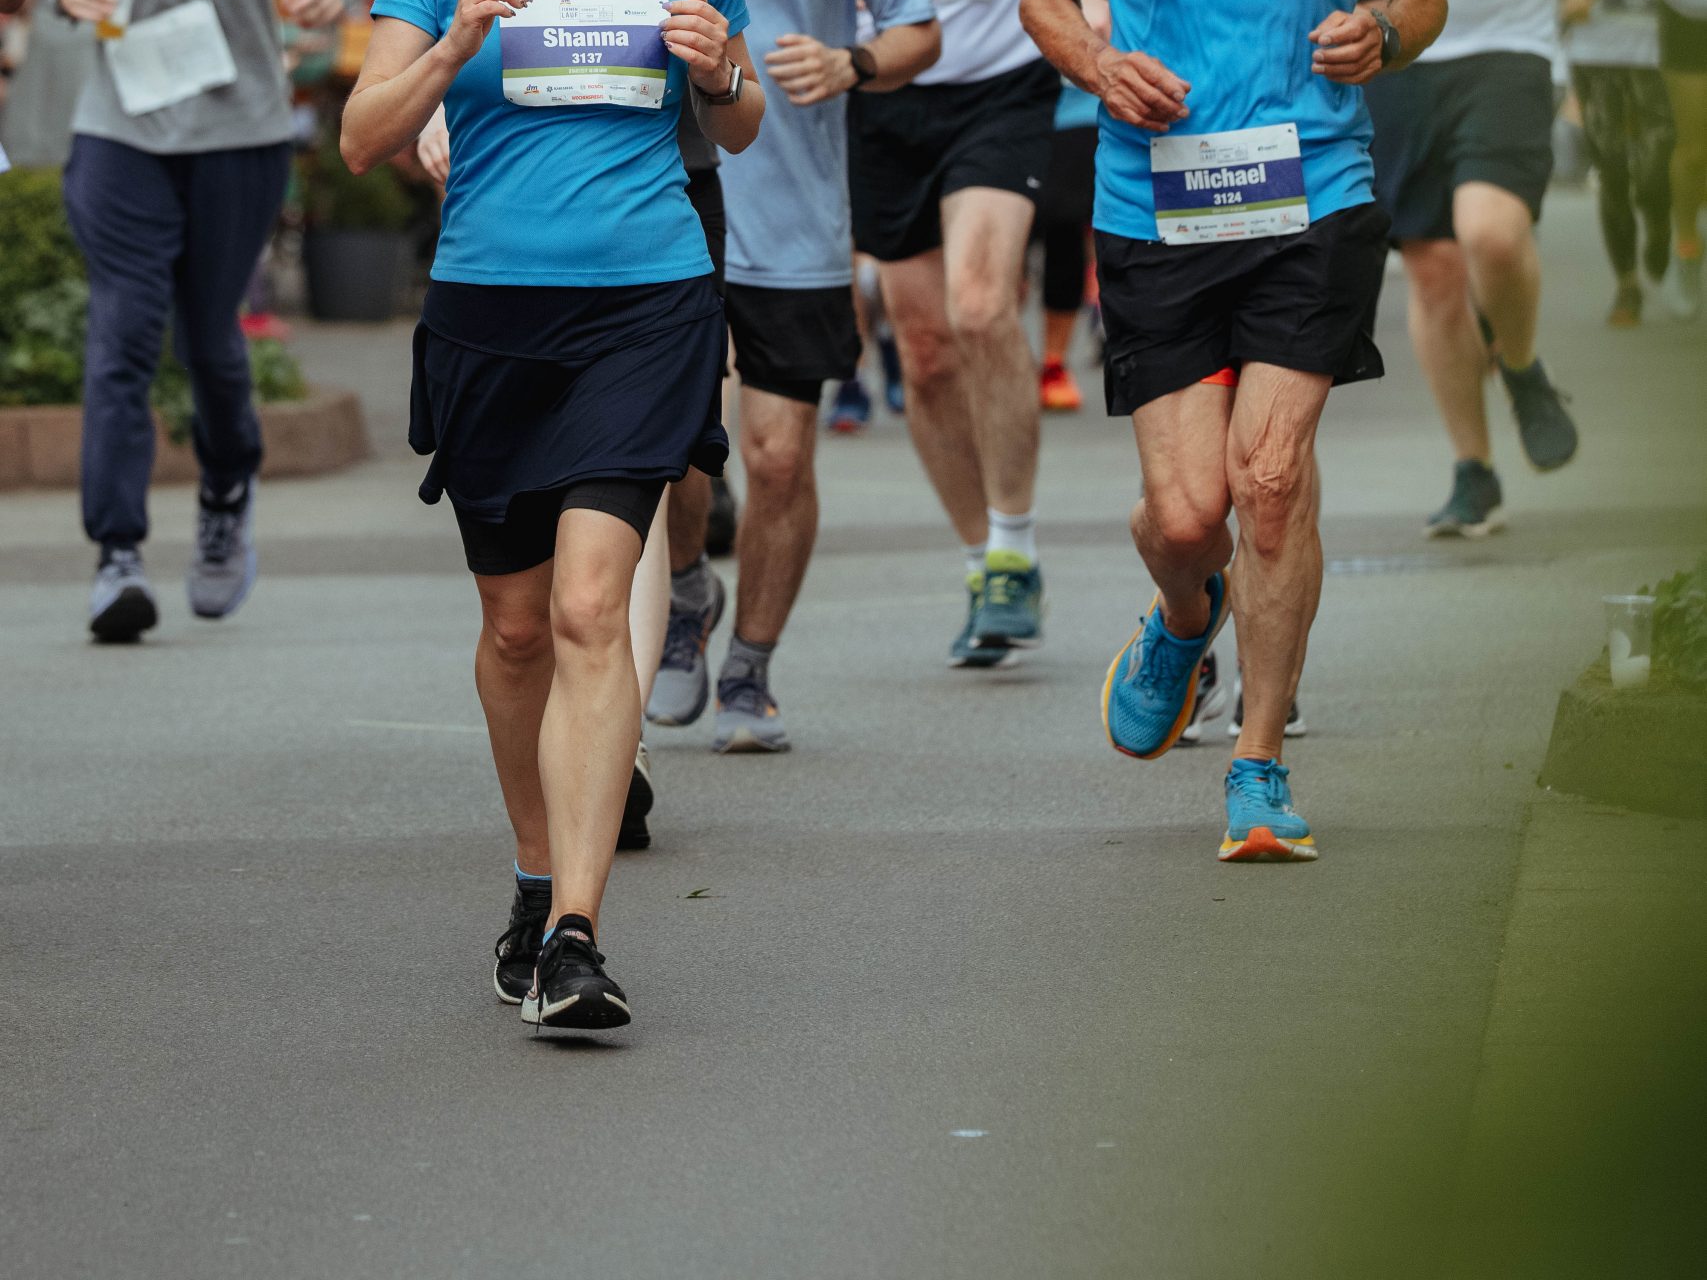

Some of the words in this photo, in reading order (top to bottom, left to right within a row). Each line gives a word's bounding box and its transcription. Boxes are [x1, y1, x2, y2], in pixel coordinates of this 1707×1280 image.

[543, 28, 629, 48] Shanna
[572, 53, 602, 64] 3137
[1185, 163, 1266, 191] Michael
[1214, 192, 1242, 205] 3124
